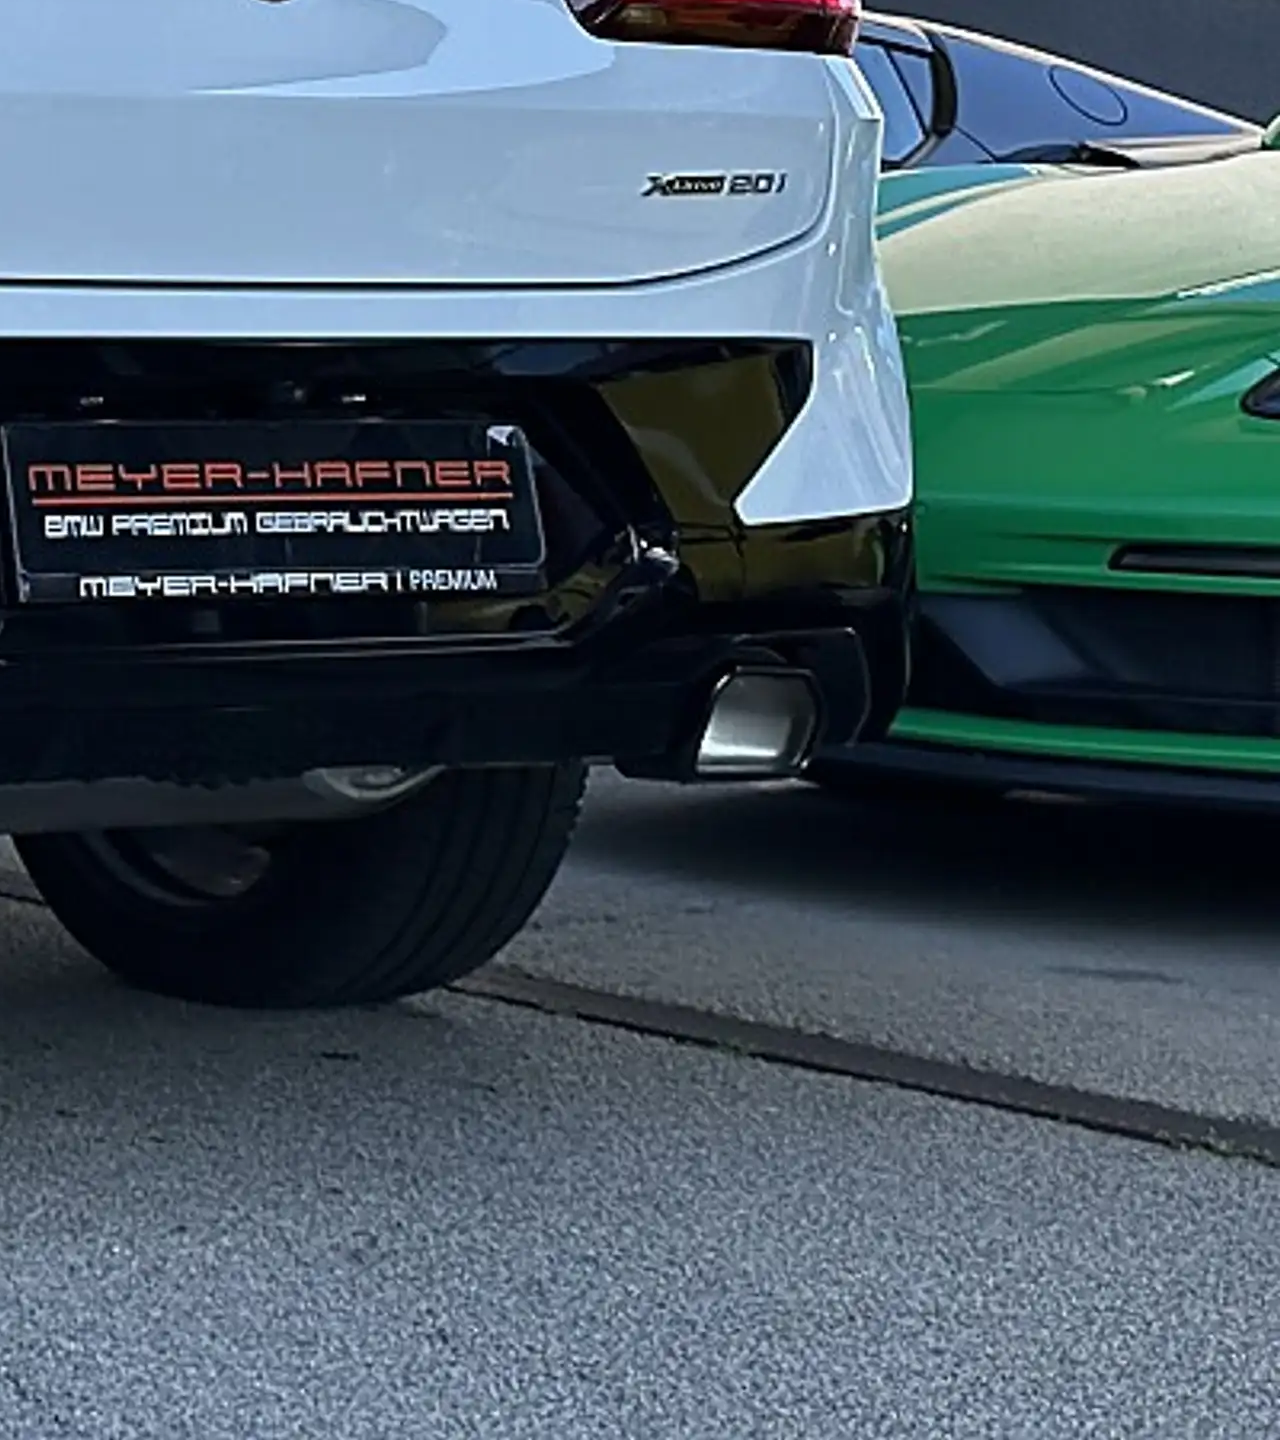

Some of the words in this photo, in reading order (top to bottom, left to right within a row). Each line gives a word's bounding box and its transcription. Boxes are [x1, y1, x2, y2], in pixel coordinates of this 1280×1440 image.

[28, 460, 512, 491] MEYER-HAFNER
[44, 514, 104, 539] BMW
[79, 572, 389, 597] MEYER-HAFNER
